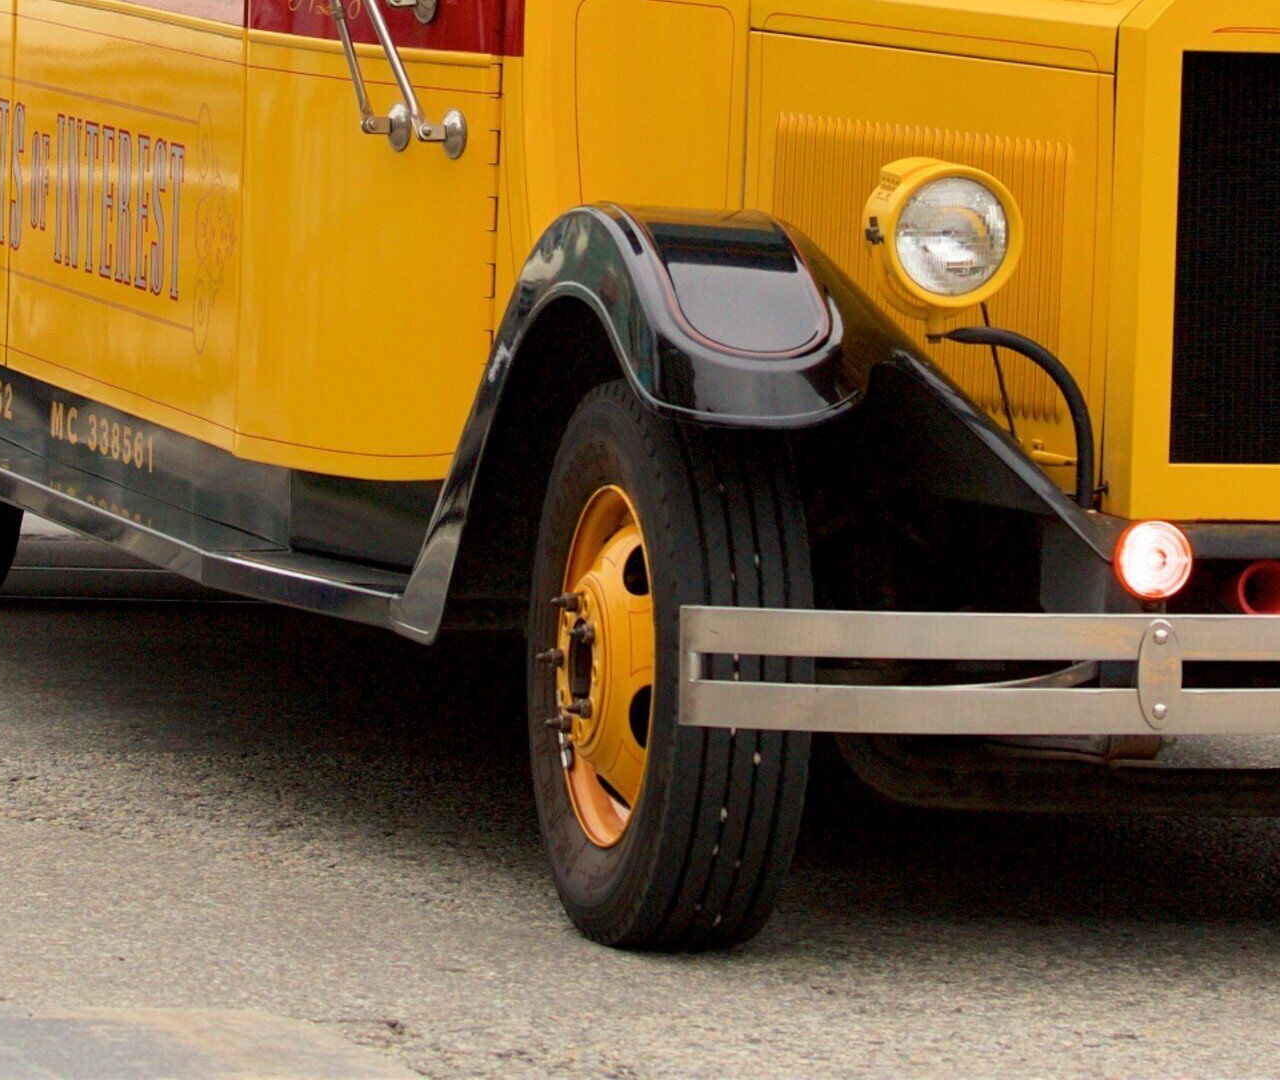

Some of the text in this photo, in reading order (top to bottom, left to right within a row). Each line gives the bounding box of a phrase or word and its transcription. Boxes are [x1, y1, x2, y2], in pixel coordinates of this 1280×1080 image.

[30, 131, 51, 231] OF
[53, 113, 185, 302] INTEREST
[50, 401, 79, 445] MC
[87, 414, 154, 474] 338561
